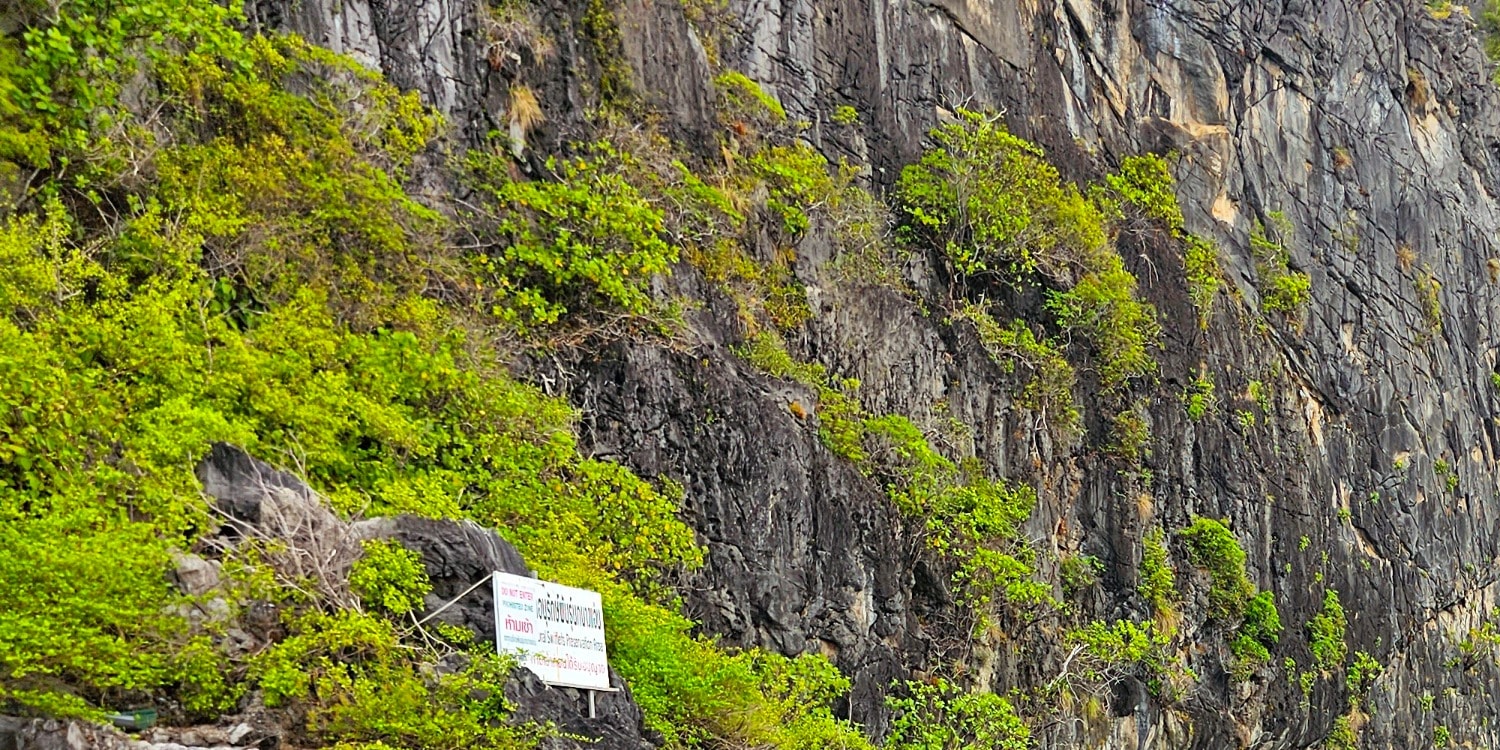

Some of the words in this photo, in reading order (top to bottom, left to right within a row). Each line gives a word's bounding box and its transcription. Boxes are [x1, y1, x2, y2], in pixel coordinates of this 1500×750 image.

[501, 586, 508, 595] DO
[509, 588, 518, 597] NOT
[519, 590, 533, 601] ENTER
[505, 614, 534, 634] ห้ามเข้า
[566, 633, 593, 650] Preservation
